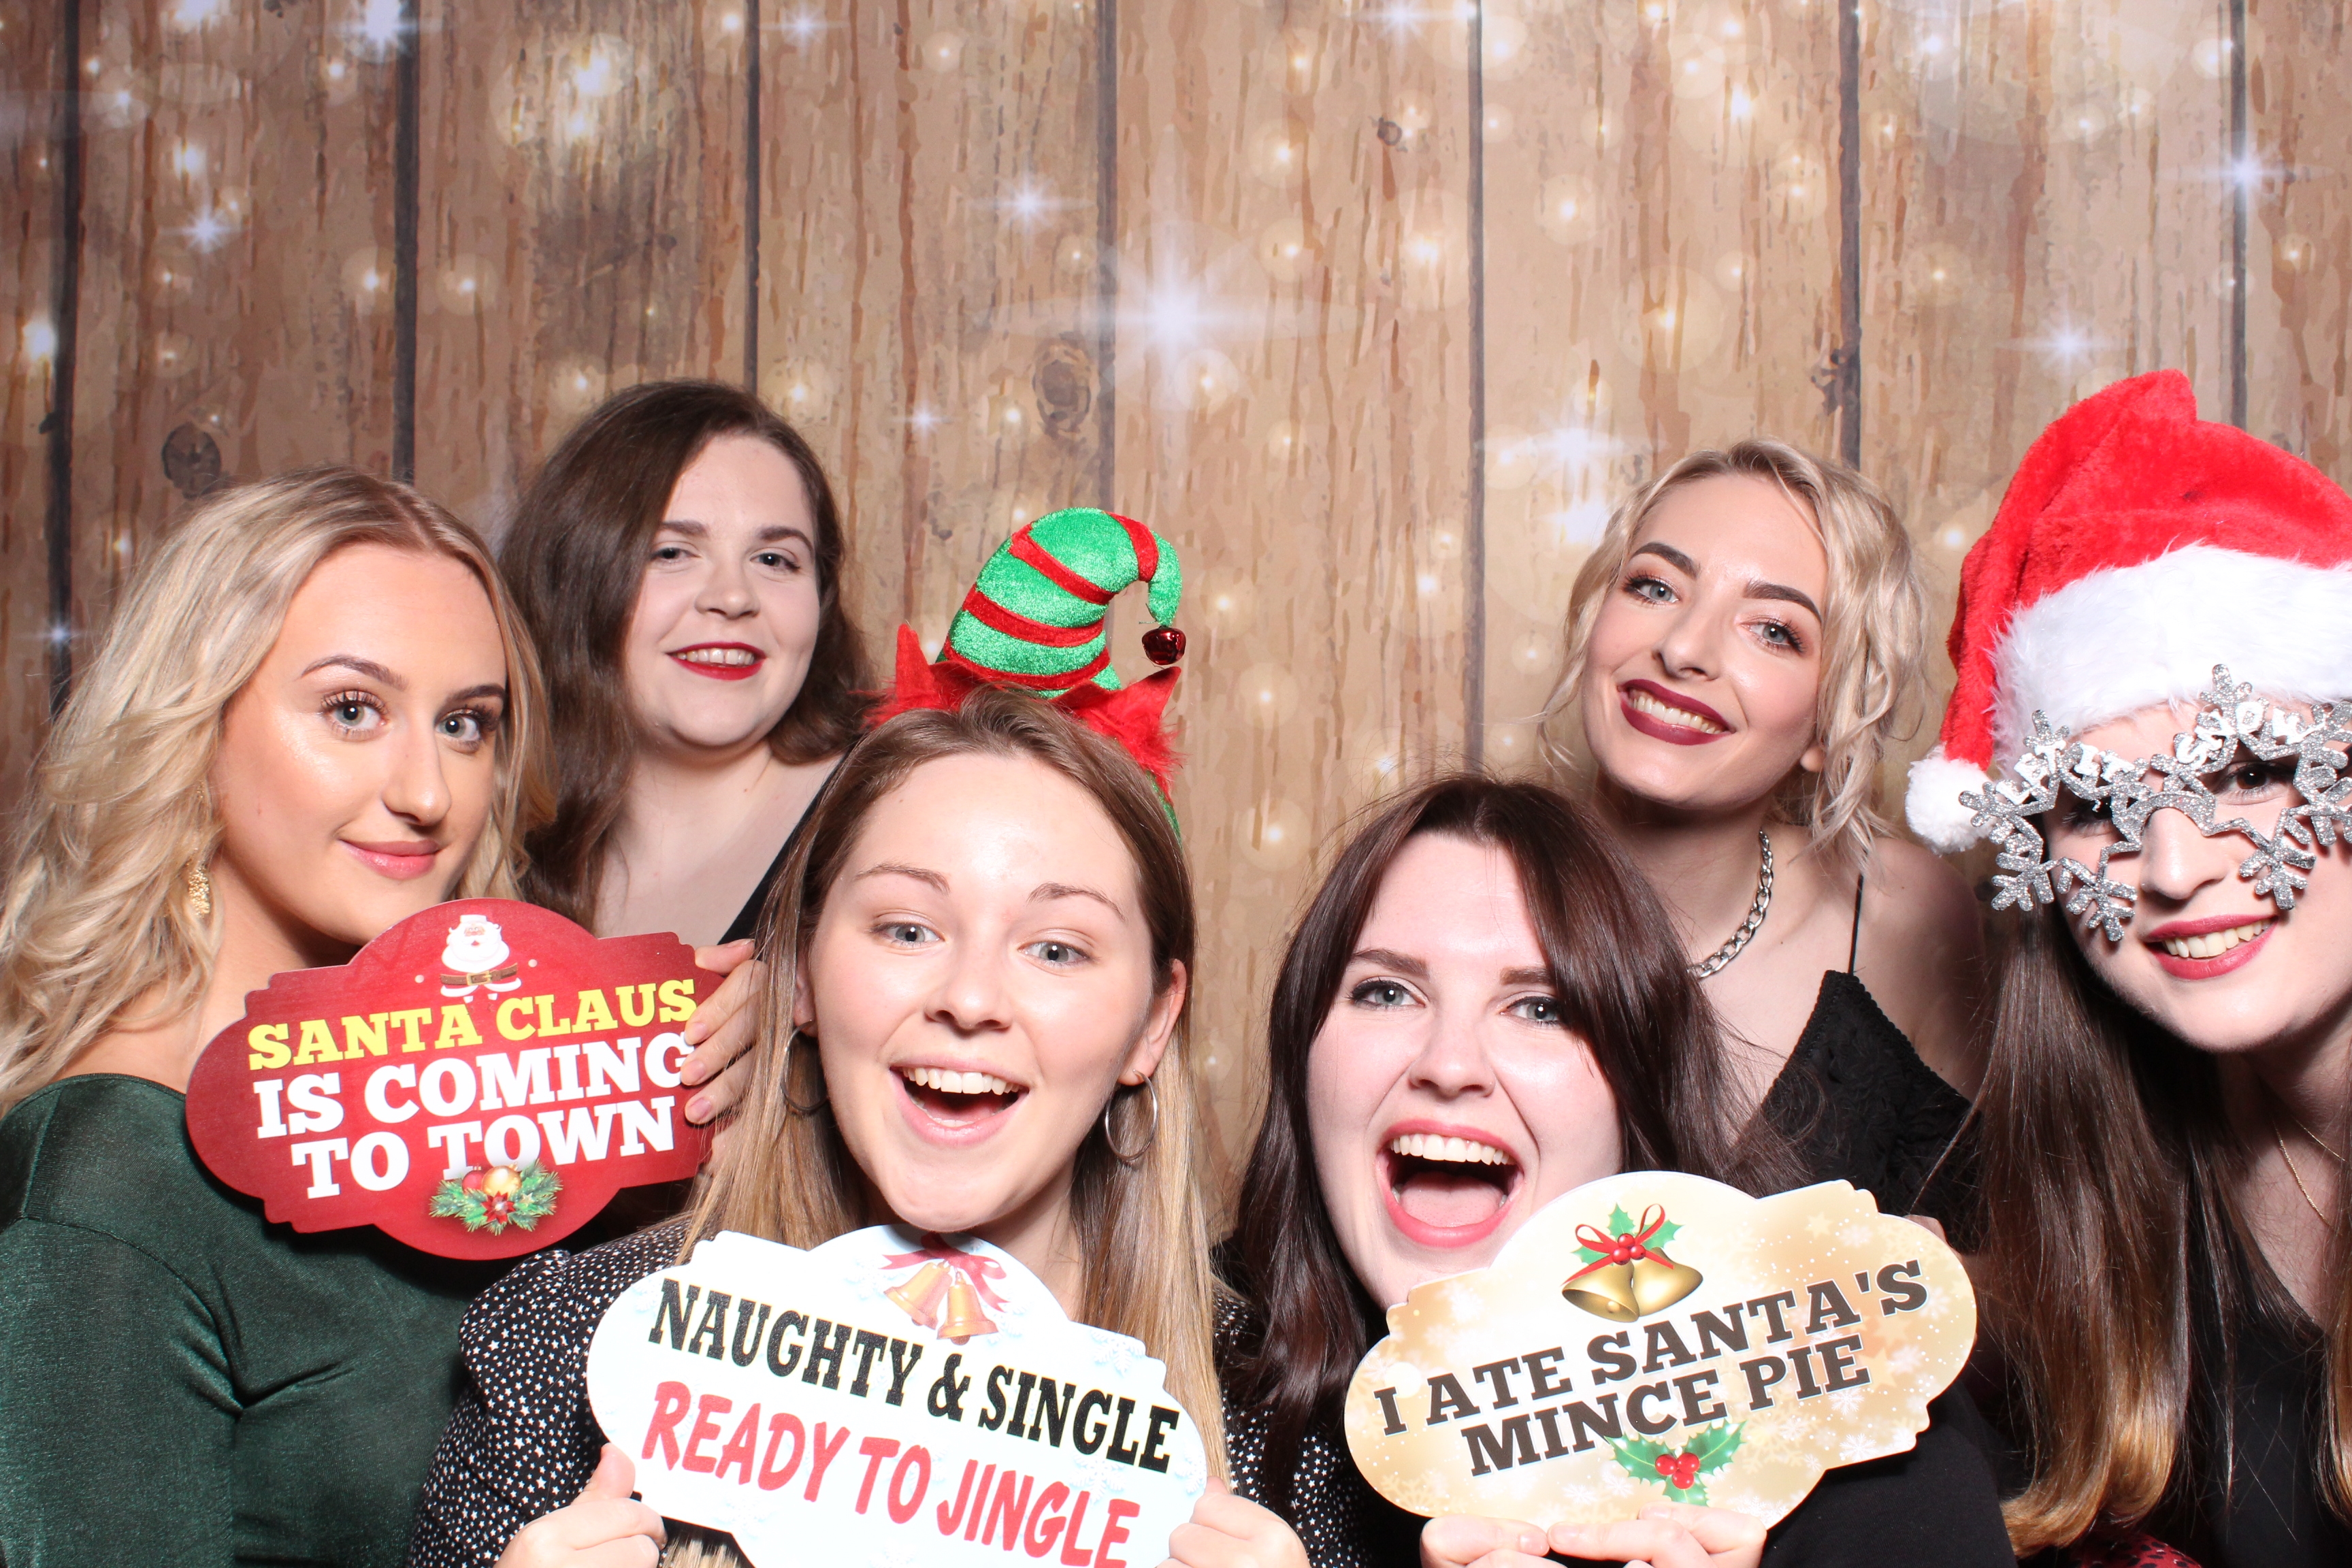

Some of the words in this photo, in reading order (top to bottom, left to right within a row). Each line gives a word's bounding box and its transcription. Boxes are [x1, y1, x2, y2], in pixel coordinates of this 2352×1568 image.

[1995, 739, 2067, 805] LET
[2074, 742, 2136, 783] IT
[248, 1004, 482, 1071] SANTA
[495, 979, 697, 1041] CLAUS
[253, 1072, 344, 1139] IS
[363, 1031, 695, 1124] COMING
[291, 1131, 409, 1198] TO
[427, 1095, 675, 1180] TOWN
[648, 1278, 924, 1407] NAUGHTY
[928, 1352, 973, 1421] &
[978, 1365, 1180, 1474] SINGLE
[1373, 1387, 1407, 1437] I
[1426, 1347, 1573, 1426] ATE
[1586, 1259, 1929, 1387] SANTA'S
[1461, 1371, 1727, 1477] MINCE
[1740, 1334, 1872, 1411] PIE
[642, 1380, 851, 1502] READY
[855, 1437, 931, 1524] TO
[936, 1458, 1140, 1568] JINGLE
